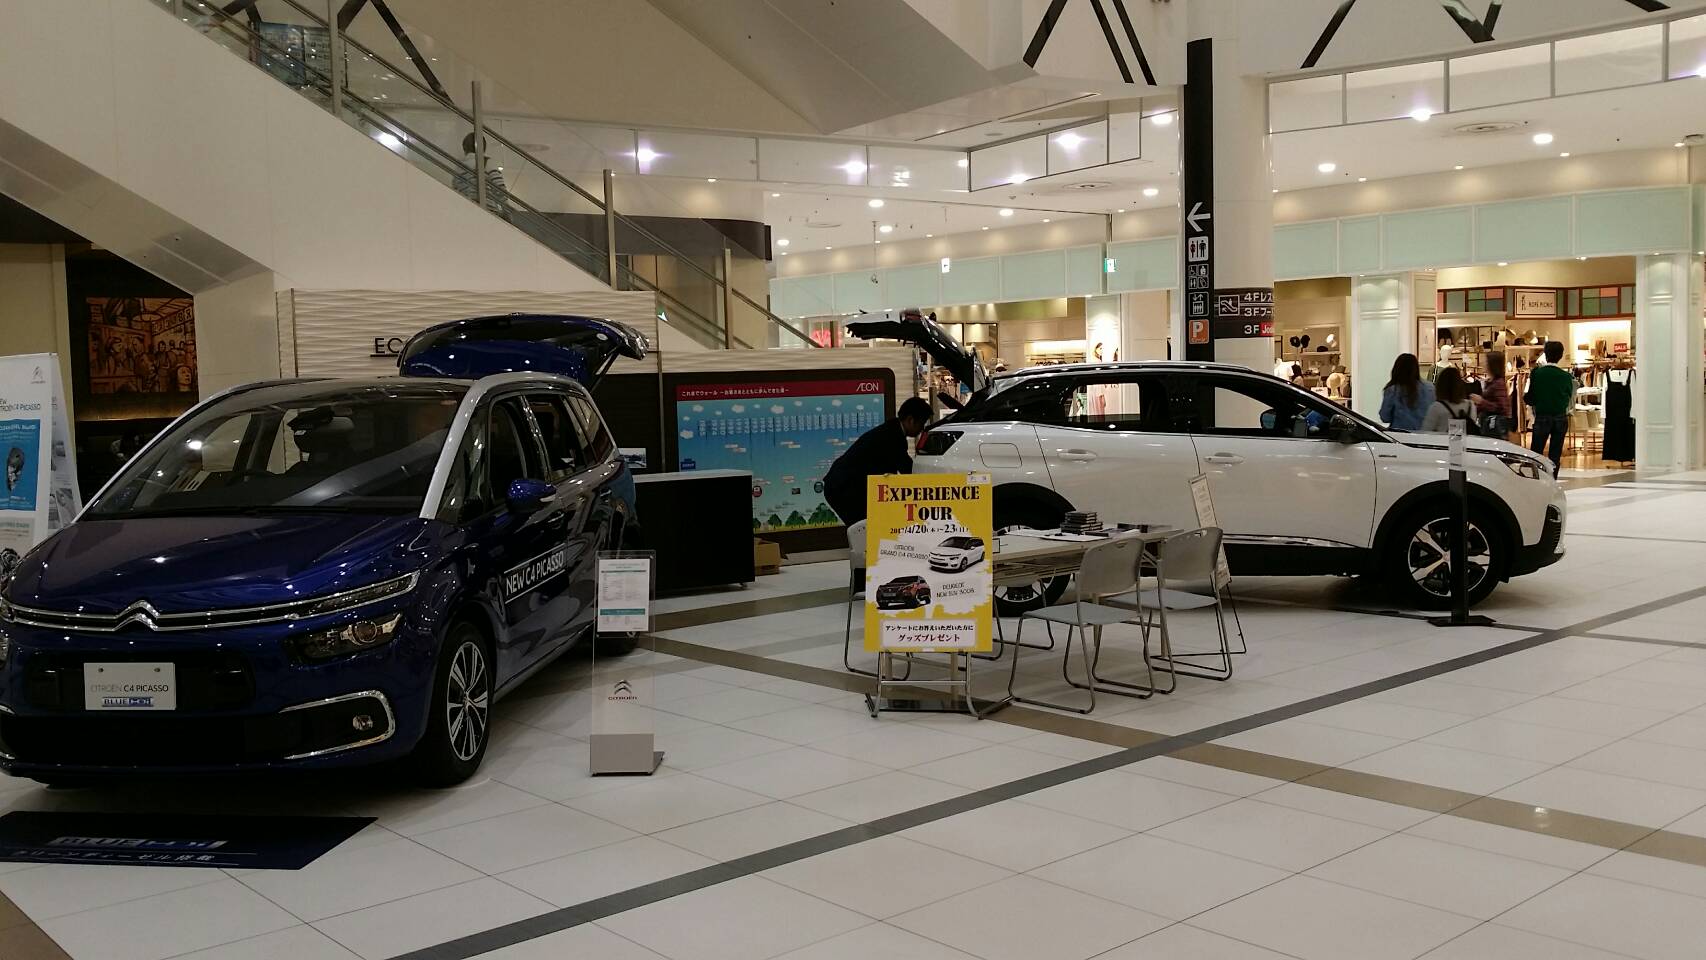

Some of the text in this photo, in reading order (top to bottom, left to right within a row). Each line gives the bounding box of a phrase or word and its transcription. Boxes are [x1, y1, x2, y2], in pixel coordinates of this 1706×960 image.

[1244, 325, 1260, 334] 3F
[877, 484, 980, 502] EXPERIENCE
[904, 503, 953, 522] TOUR
[506, 551, 564, 596] NEW C4 PICASSO
[124, 684, 134, 692] C4
[136, 684, 169, 692] PICASSO
